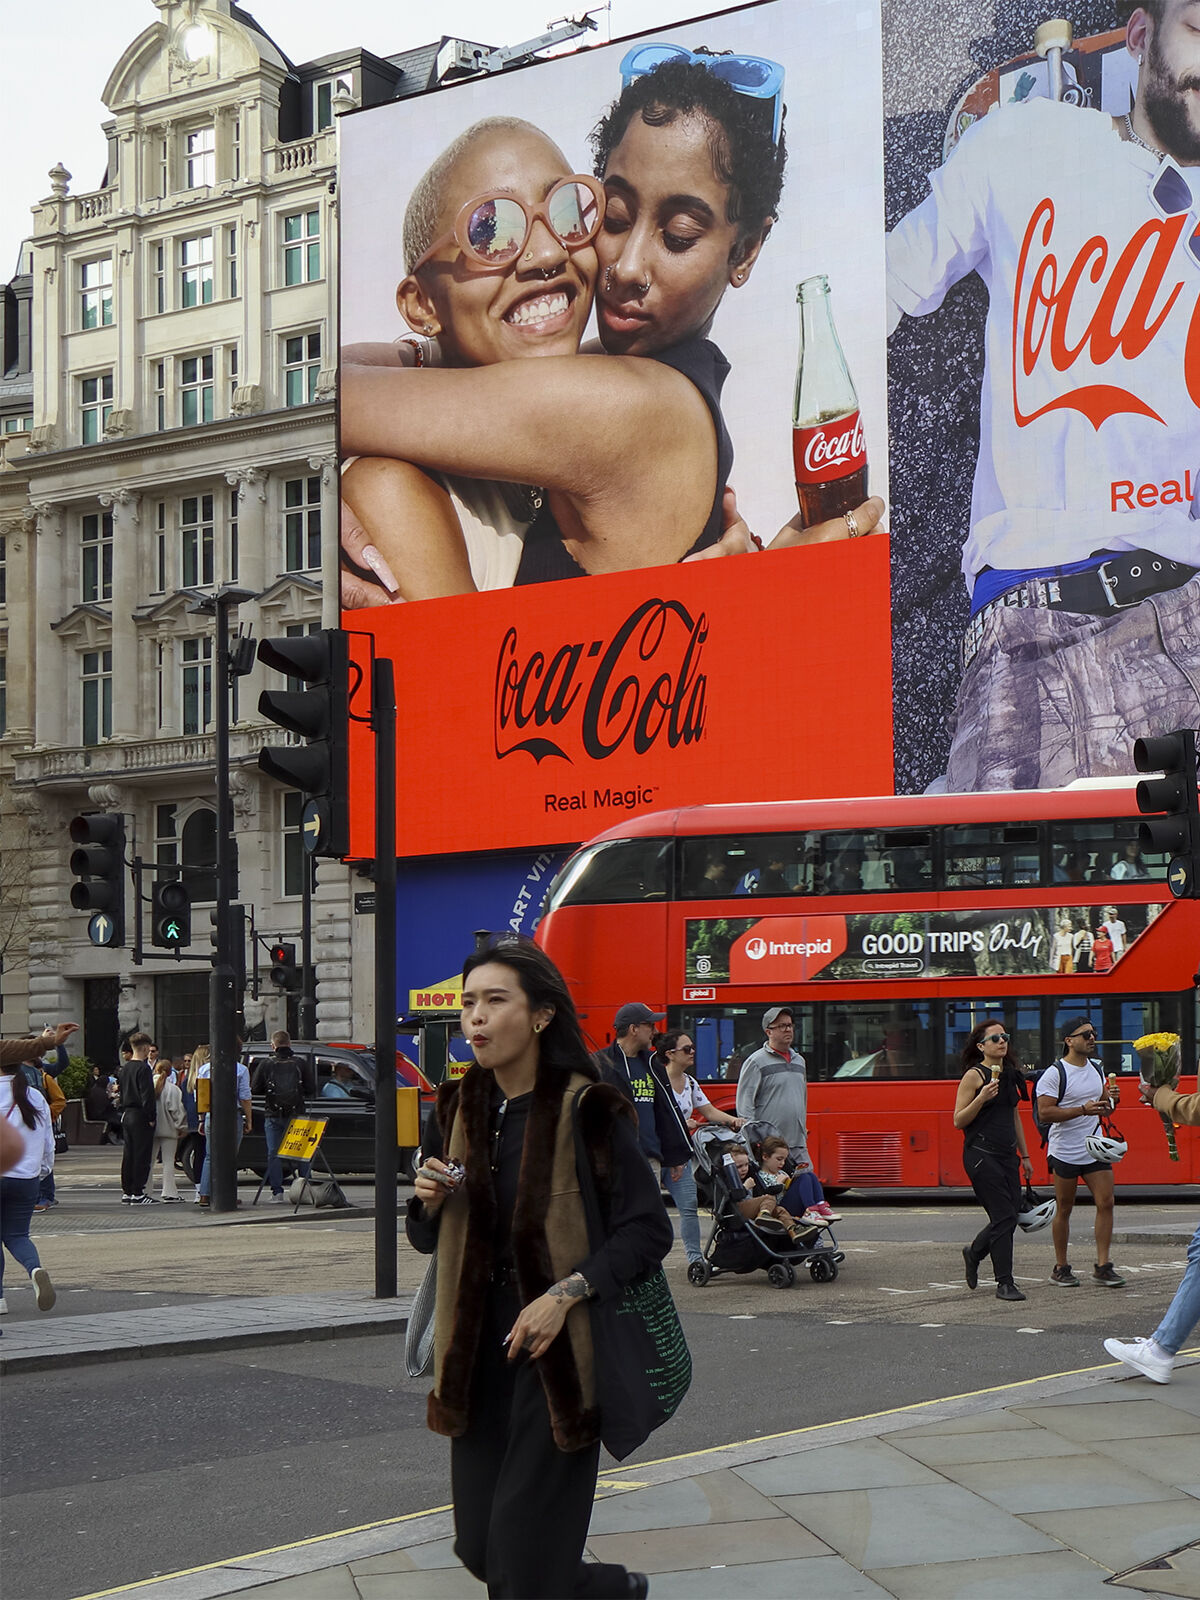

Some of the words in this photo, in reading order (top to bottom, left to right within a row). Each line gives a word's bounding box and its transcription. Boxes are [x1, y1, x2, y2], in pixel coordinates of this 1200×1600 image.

[1111, 475, 1194, 512] Real
[495, 598, 709, 766] Coca-Cola
[545, 791, 587, 812] Real
[769, 938, 832, 957] Intrepid
[862, 933, 924, 955] GOOD
[927, 930, 985, 953] TRIPS
[989, 921, 1043, 957] Only
[416, 993, 455, 1006] HOT
[689, 989, 709, 998] global
[287, 1124, 311, 1137] Diverted
[284, 1140, 302, 1151] traffic
